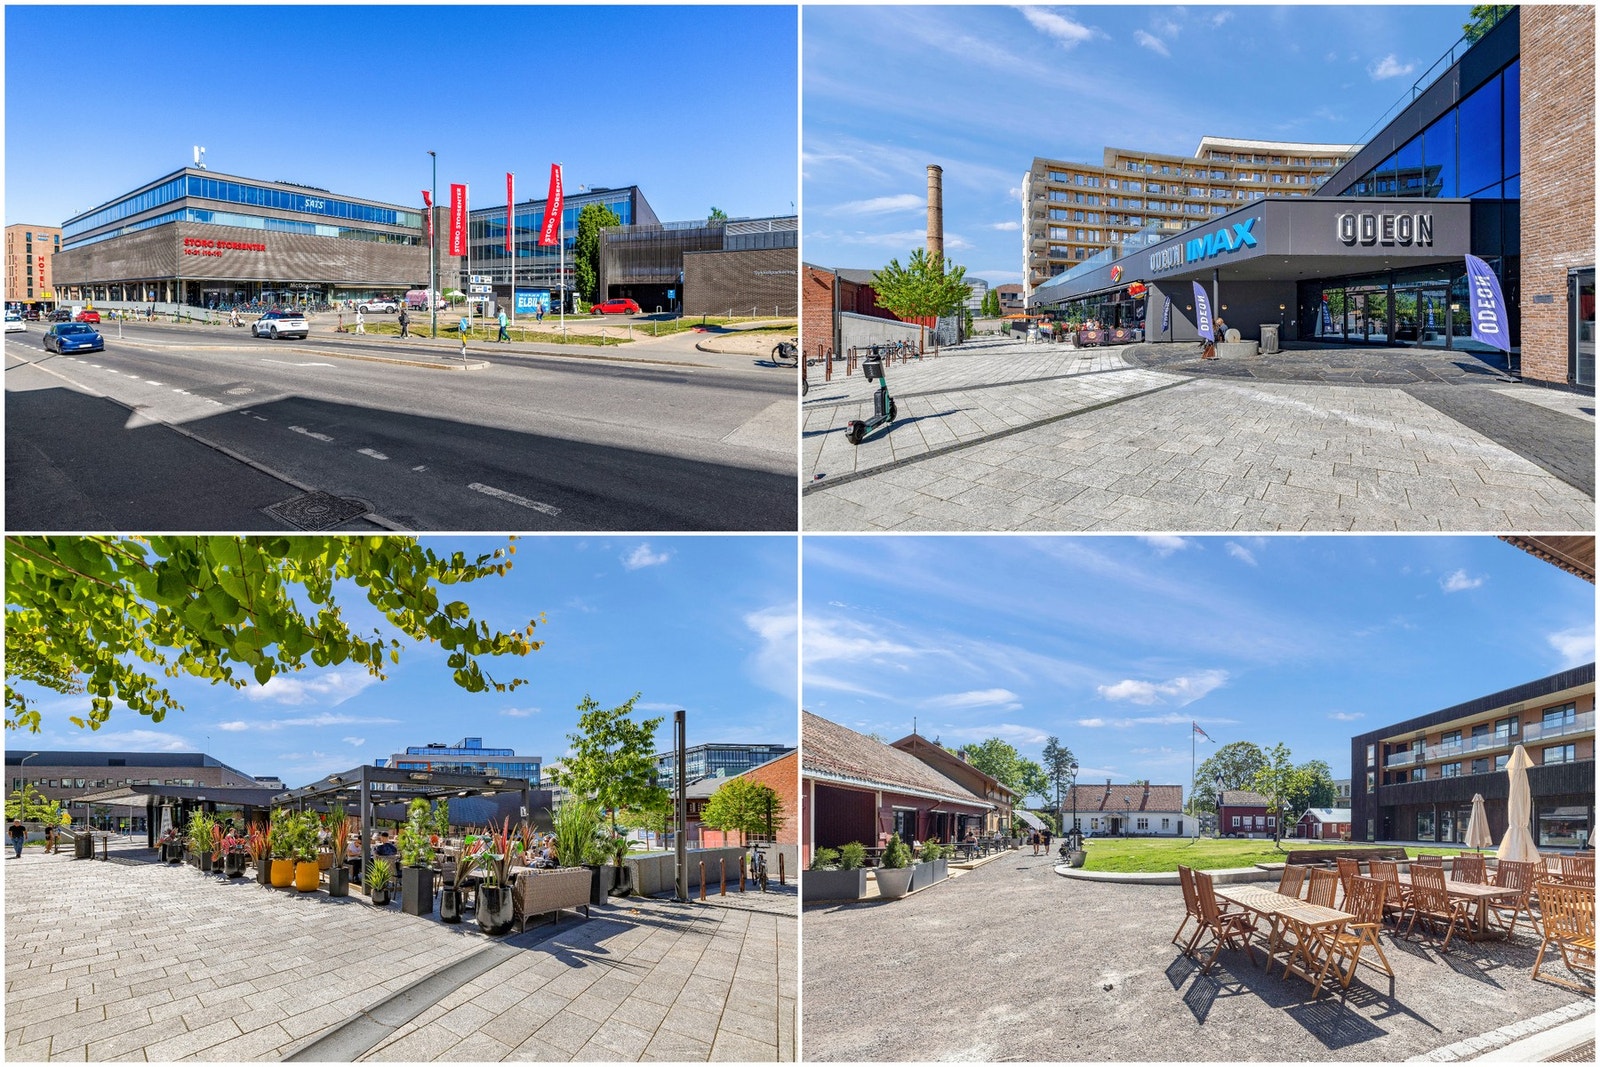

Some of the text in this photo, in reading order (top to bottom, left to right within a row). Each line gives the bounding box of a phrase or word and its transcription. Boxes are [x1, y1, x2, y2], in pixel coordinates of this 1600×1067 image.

[305, 199, 324, 209] SATS
[545, 169, 561, 242] STORO STORSENTER
[184, 238, 266, 252] STORO STORSENTER
[1150, 217, 1258, 272] ODEON IMAX
[1338, 213, 1433, 247] ODEON
[1198, 295, 1210, 331] ODEON
[1474, 275, 1499, 334] ODEON
